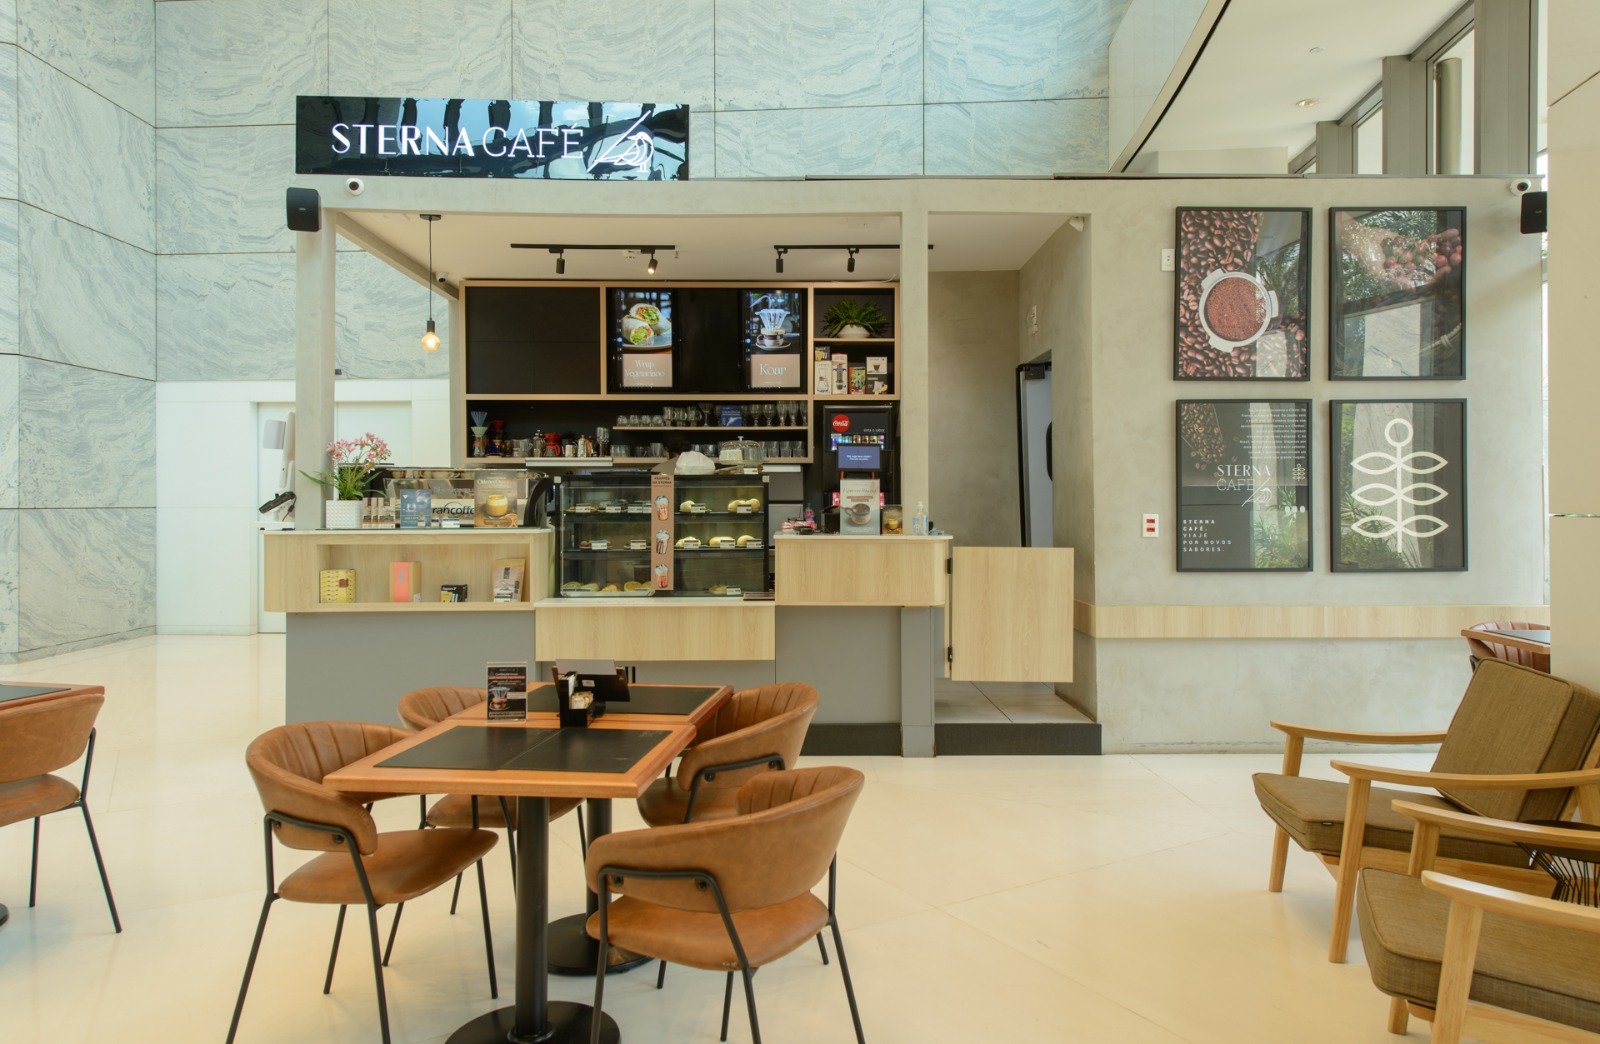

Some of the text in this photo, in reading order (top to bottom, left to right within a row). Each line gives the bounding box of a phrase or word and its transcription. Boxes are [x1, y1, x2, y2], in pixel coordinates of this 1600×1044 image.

[331, 122, 584, 159] STERNA CAFÉ
[634, 359, 655, 370] Wrap
[1216, 464, 1271, 477] STERNA
